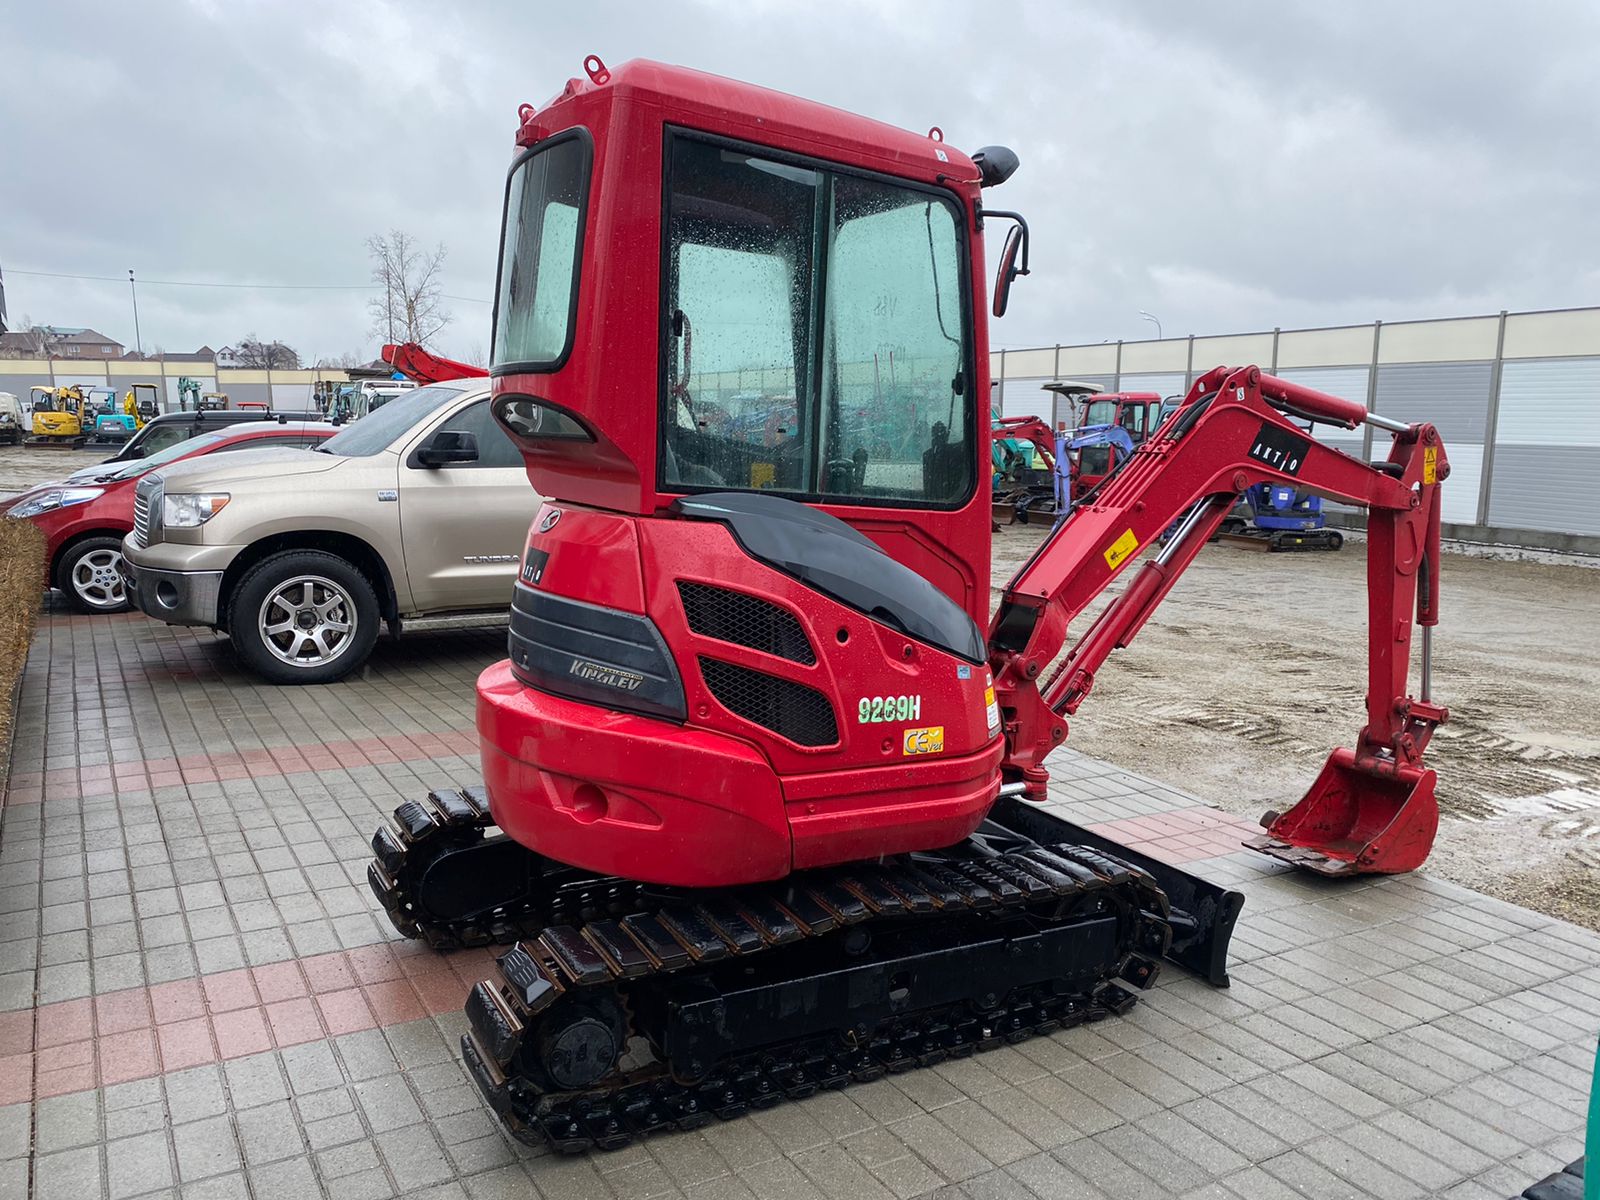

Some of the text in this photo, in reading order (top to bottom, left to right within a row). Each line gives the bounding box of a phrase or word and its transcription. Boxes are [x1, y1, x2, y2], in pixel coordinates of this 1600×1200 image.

[1253, 443, 1298, 472] AKTIO
[463, 554, 520, 565] TUNDRA
[569, 659, 643, 691] KINGLEV
[858, 694, 921, 724] 9269H
